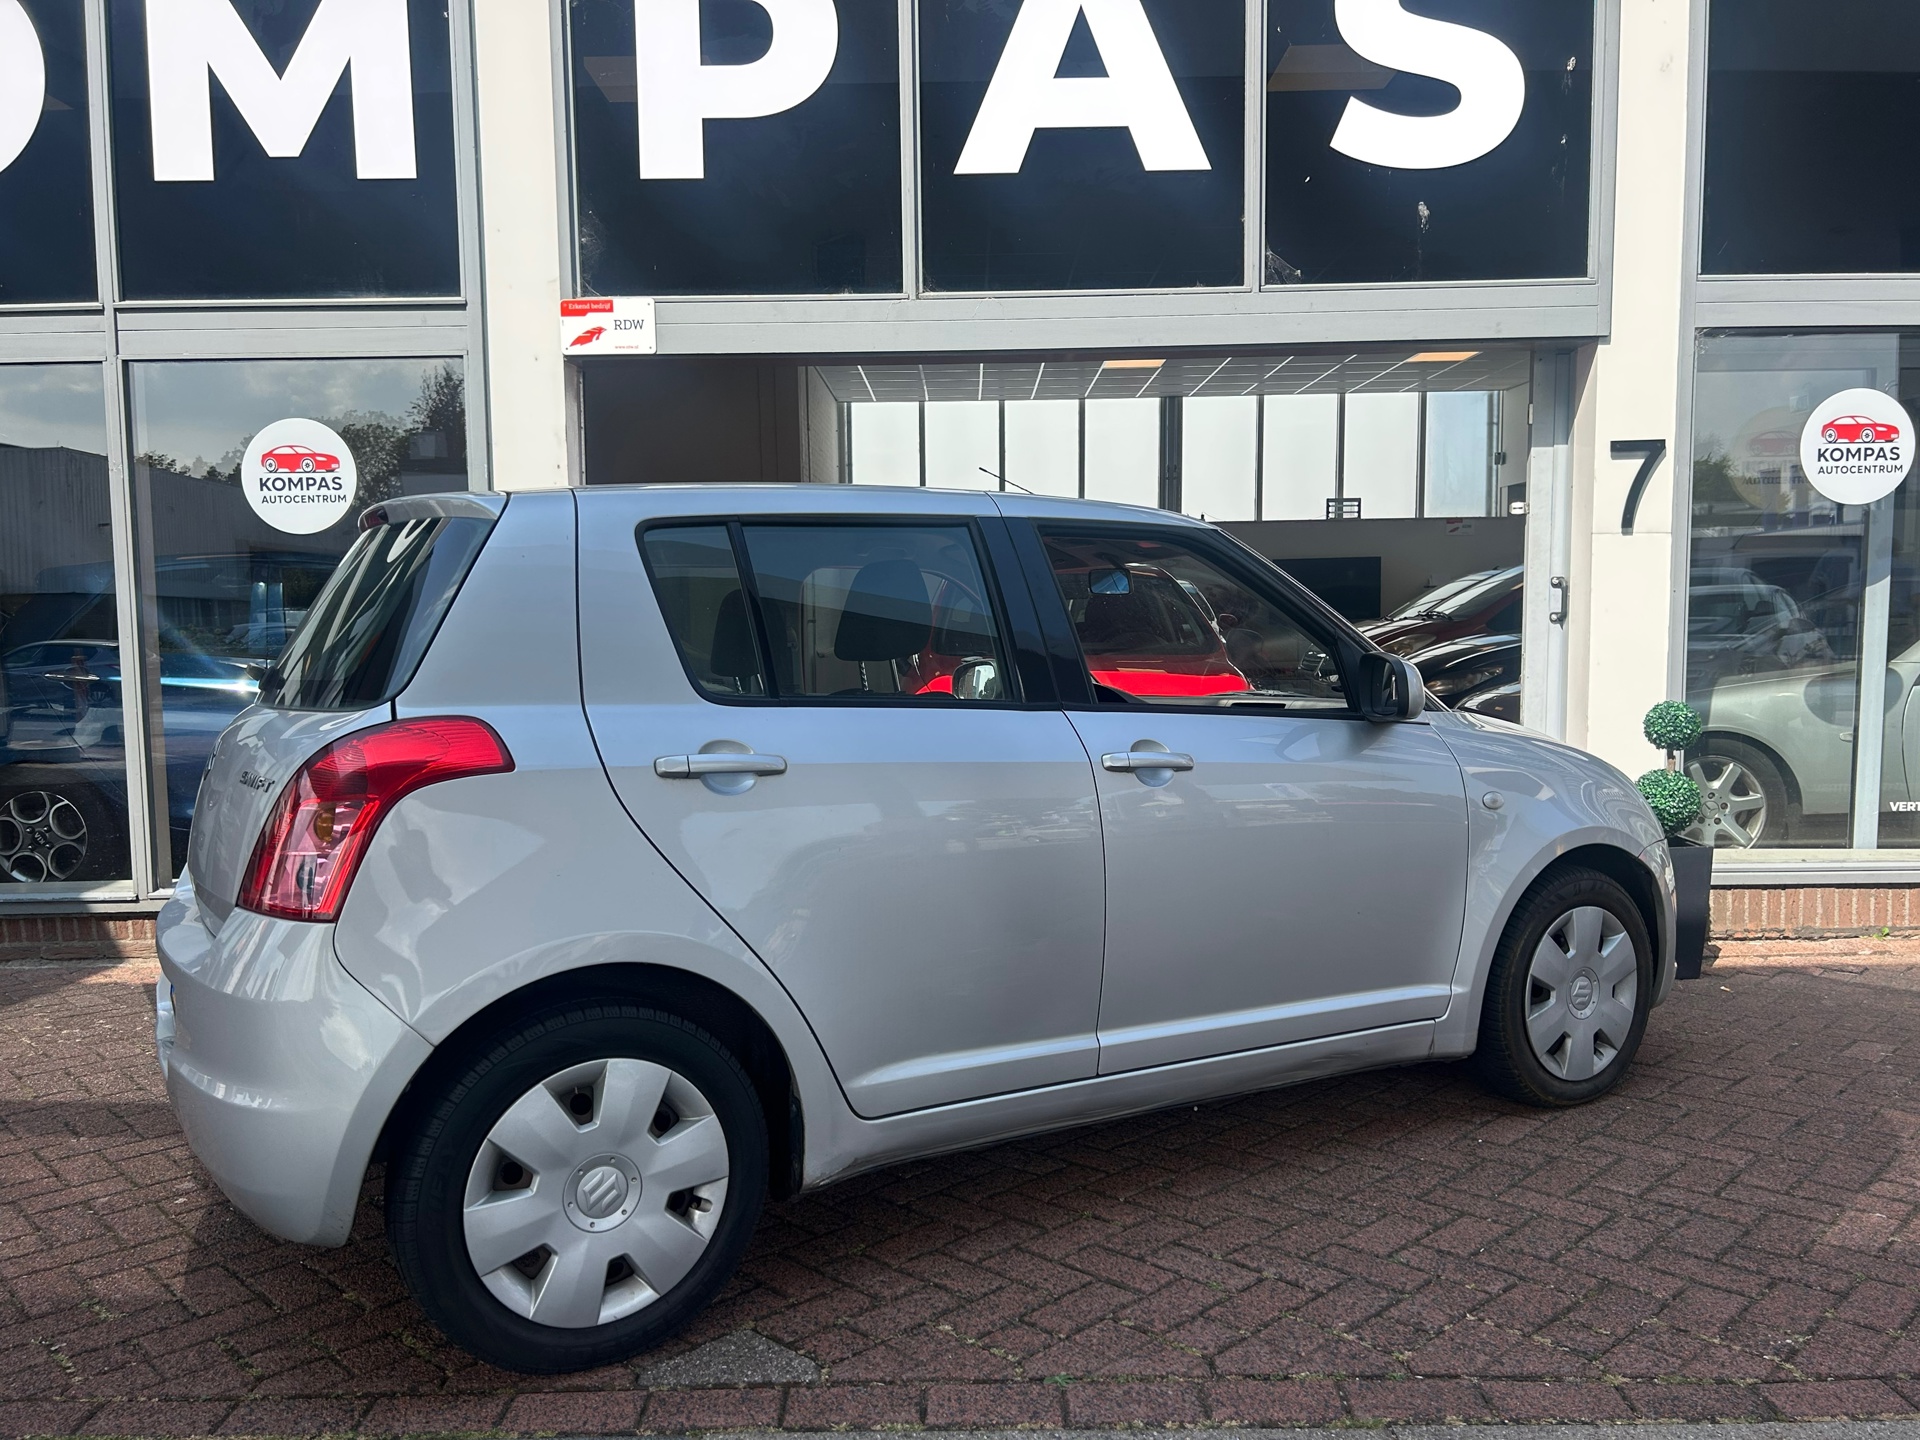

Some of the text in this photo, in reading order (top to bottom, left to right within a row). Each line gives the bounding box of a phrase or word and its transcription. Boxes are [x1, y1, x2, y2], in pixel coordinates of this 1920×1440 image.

[0, 0, 1525, 181] MPAS
[568, 302, 611, 311] Erkend bedrijf
[613, 319, 645, 331] RDW
[1817, 446, 1901, 463] KOMPAS
[1817, 464, 1903, 475] AUTOCENTRUM
[259, 476, 343, 492] KOMPAS
[1609, 438, 1667, 536] 7
[261, 494, 347, 504] AUTOCENTRUM
[239, 770, 276, 793] SWIFT
